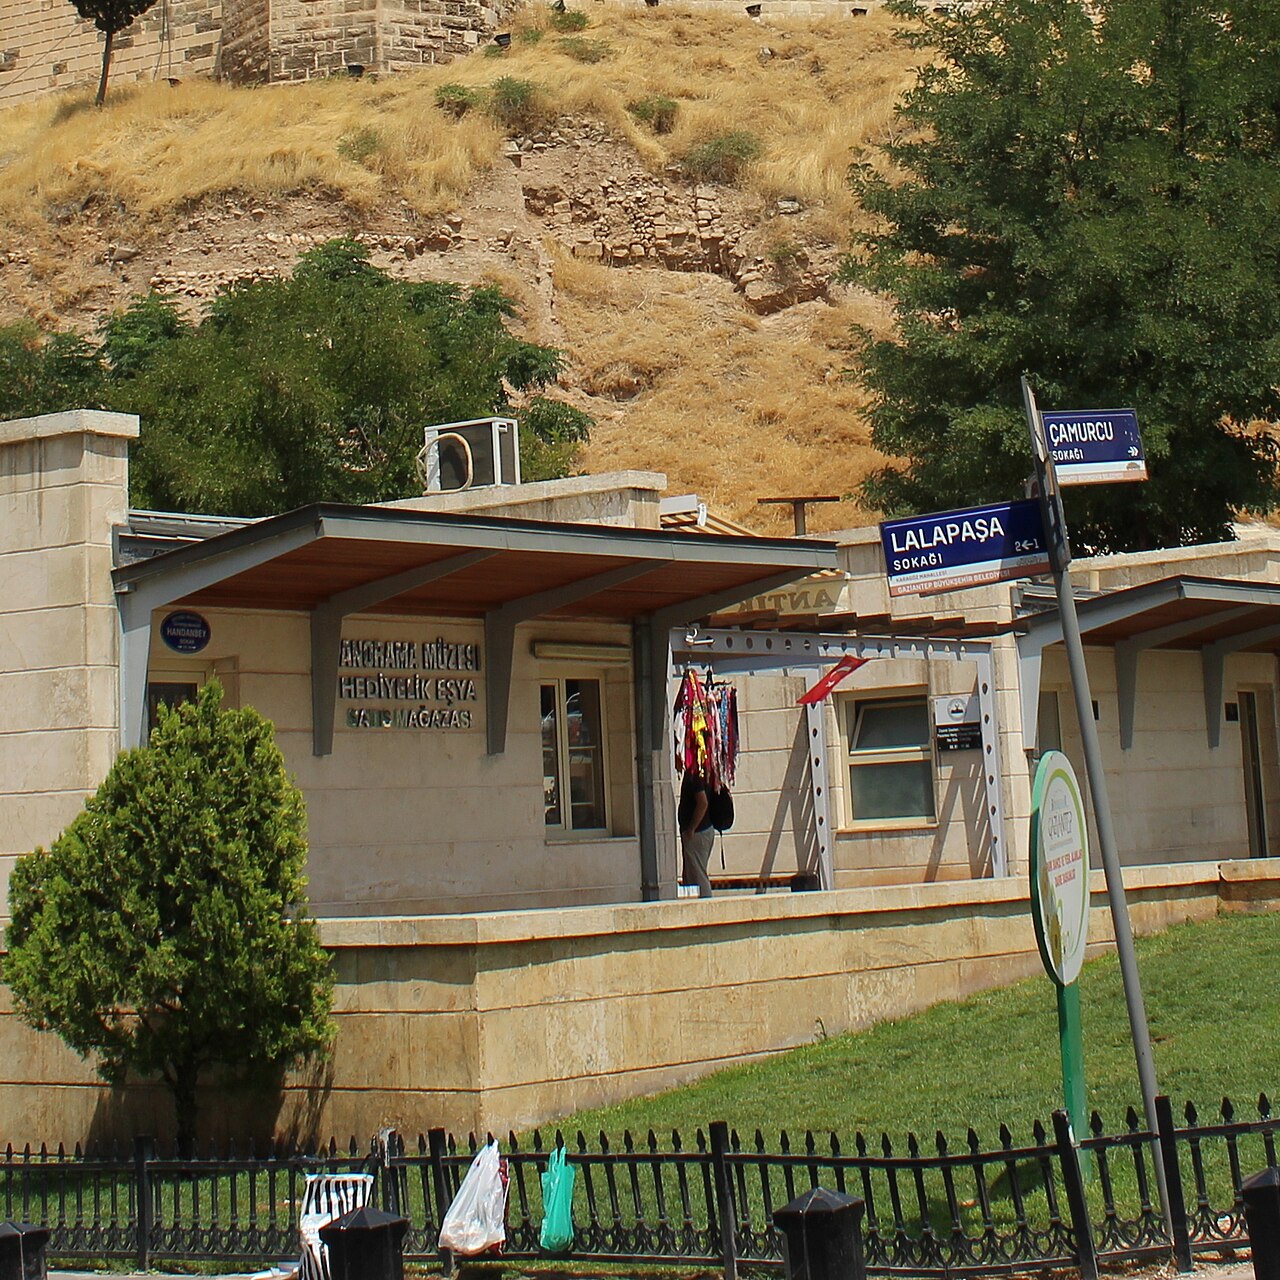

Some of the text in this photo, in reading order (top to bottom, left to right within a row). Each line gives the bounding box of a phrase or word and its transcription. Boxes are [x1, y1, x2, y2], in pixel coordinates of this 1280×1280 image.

[1049, 421, 1114, 447] ÇAMURCU
[1052, 447, 1084, 461] SOKAĞI
[890, 517, 1005, 553] LALAPAŞA
[1014, 538, 1040, 552] 2 1
[893, 553, 943, 571] SOKAĞI
[897, 570, 1011, 594] GAZİANTEP BÜYÜKŞEHİR BELEDİYESİ
[166, 626, 208, 638] HANDANBEY
[339, 639, 418, 669] ANORAMA
[339, 672, 477, 706] HEDİYELİK EŞYA
